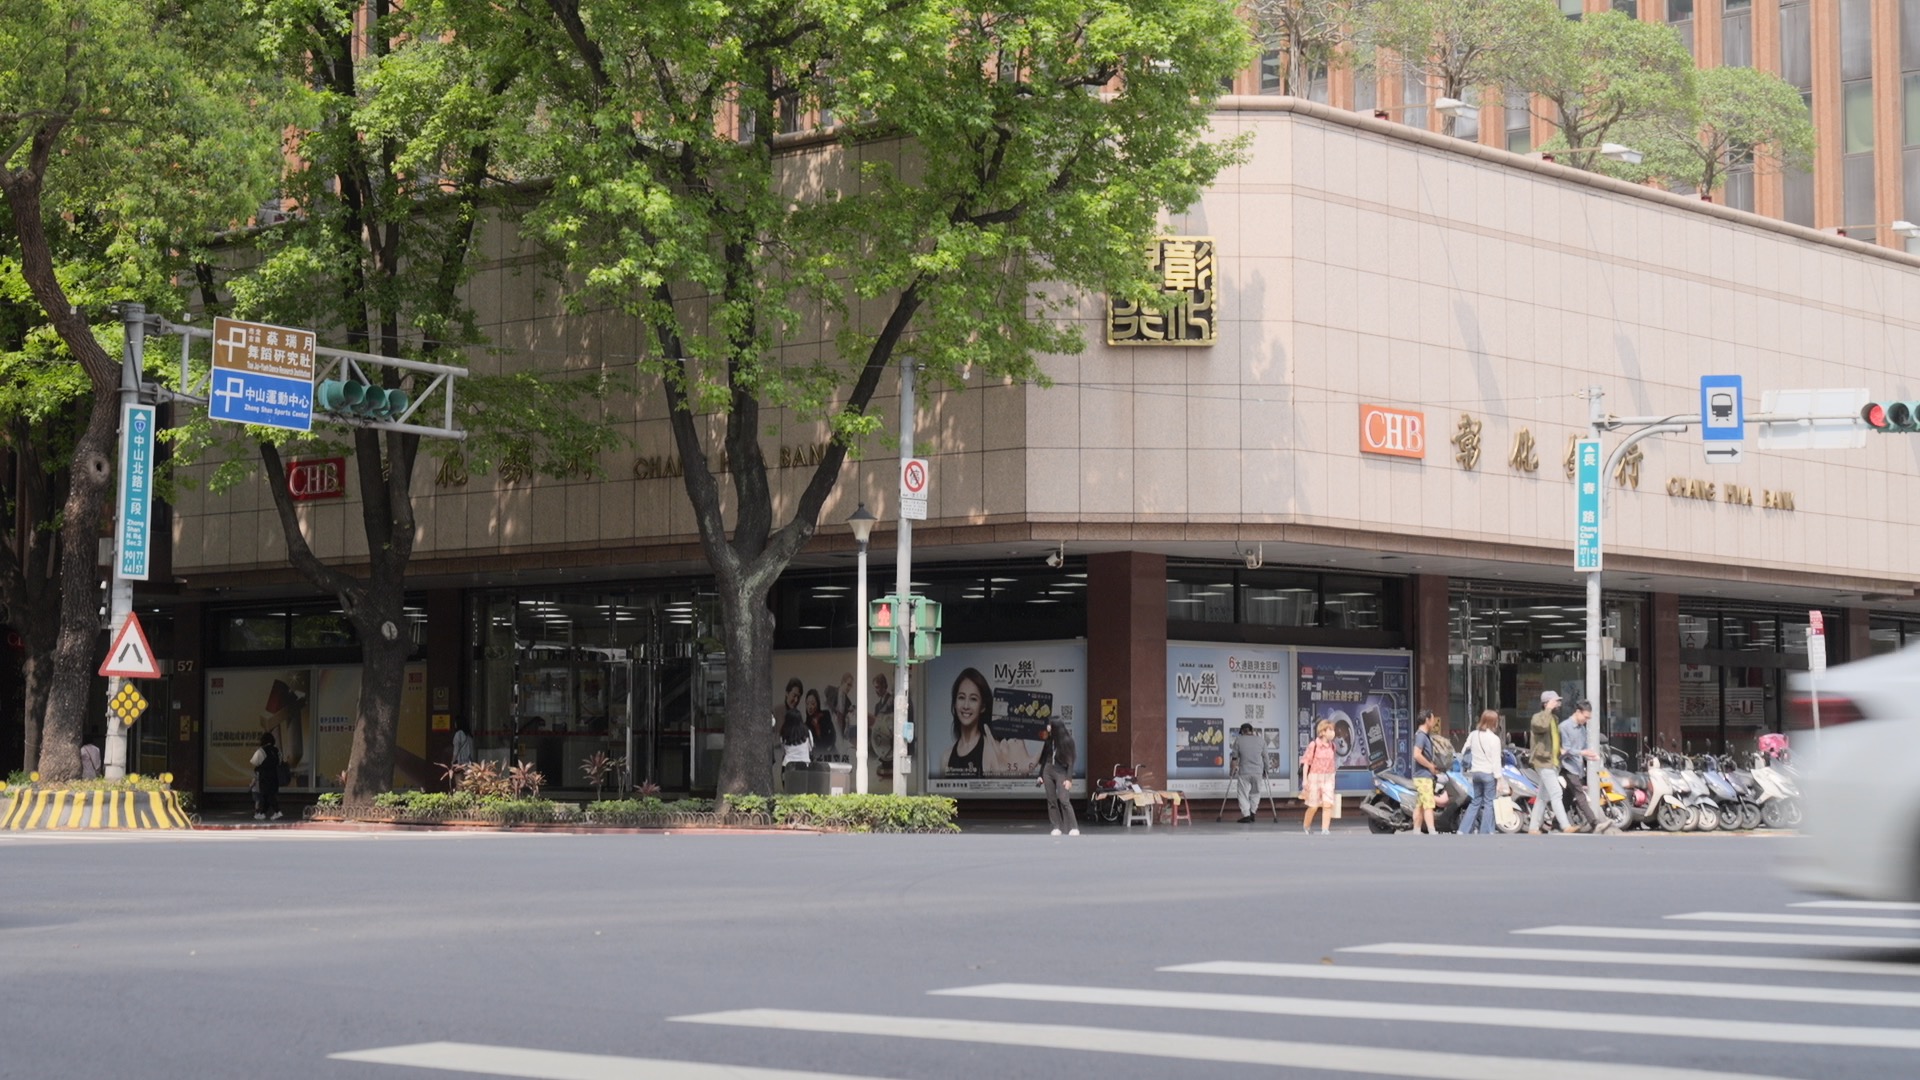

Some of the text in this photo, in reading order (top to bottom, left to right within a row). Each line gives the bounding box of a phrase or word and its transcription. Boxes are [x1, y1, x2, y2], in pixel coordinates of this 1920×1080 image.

[248, 345, 311, 368] 舞蹈研究社
[245, 386, 309, 409] 中山運動中心
[244, 404, 308, 418] Zhong Shan Sports Center
[1365, 410, 1423, 452] CHB
[779, 443, 827, 468] BAN
[130, 435, 144, 515] 中山北路二段
[289, 462, 339, 496] CHB
[1583, 454, 1595, 523] 長春路
[1666, 477, 1795, 511] CHANG HWA BANK
[126, 519, 144, 528] Zhong
[124, 551, 143, 560] 90 77
[123, 565, 143, 573] 44 57
[177, 660, 194, 671] 57
[994, 660, 1033, 685] My樂
[1177, 672, 1217, 702] My樂
